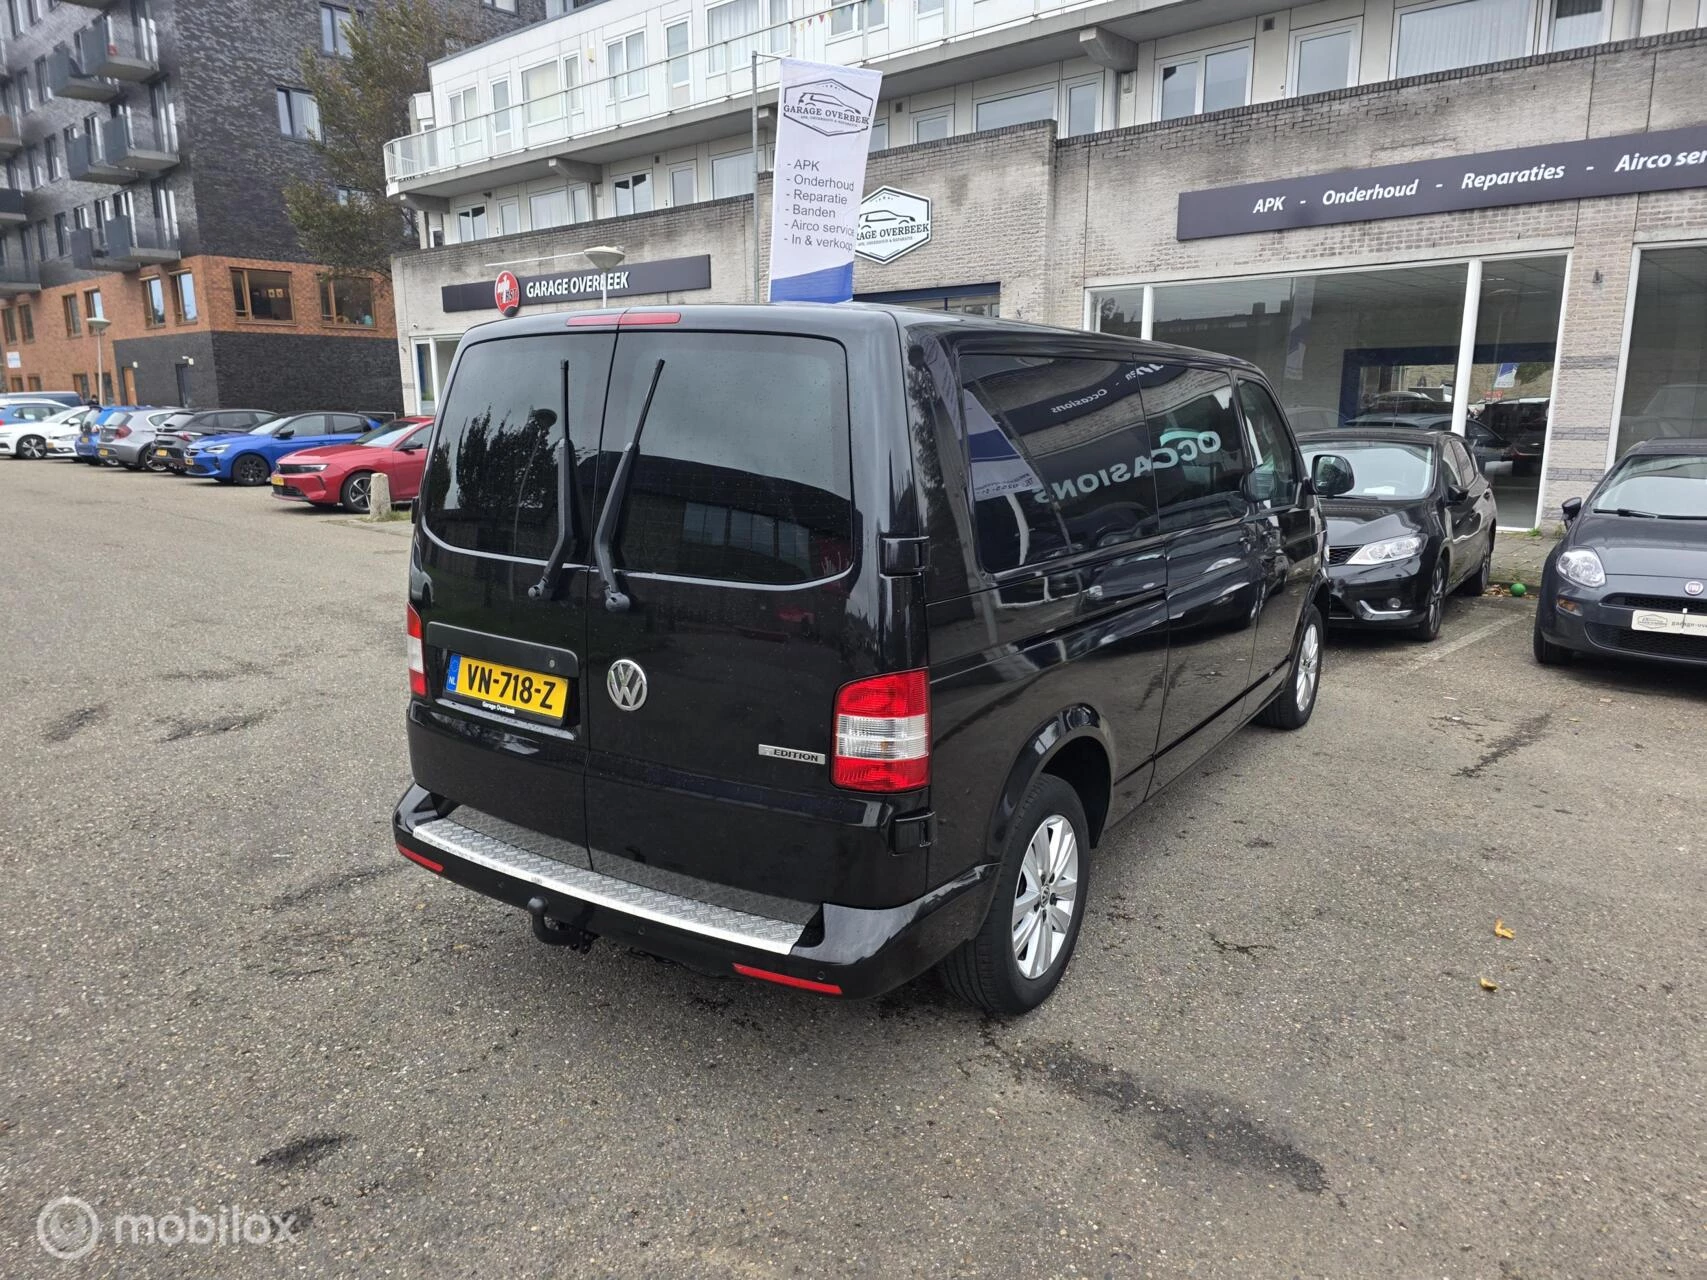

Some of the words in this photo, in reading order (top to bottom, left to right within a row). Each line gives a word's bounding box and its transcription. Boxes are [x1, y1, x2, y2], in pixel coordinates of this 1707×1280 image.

[783, 104, 823, 116] GARAGE
[793, 159, 820, 172] APK
[794, 174, 855, 192] Onderhoud
[1253, 195, 1287, 215] APK
[1322, 179, 1419, 206] Onderhoud
[1461, 163, 1565, 191] Reparaties
[1614, 152, 1673, 173] Airco
[793, 189, 848, 205] Reparatie
[792, 204, 836, 218] Banden
[791, 219, 820, 232] Airco
[879, 223, 929, 238] OVERBEEK
[791, 234, 802, 245] In
[804, 235, 813, 246] &
[526, 278, 569, 298] GARAGE
[448, 675, 456, 686] NL
[467, 663, 556, 710] VN-718-Z
[773, 748, 819, 763] EDITION
